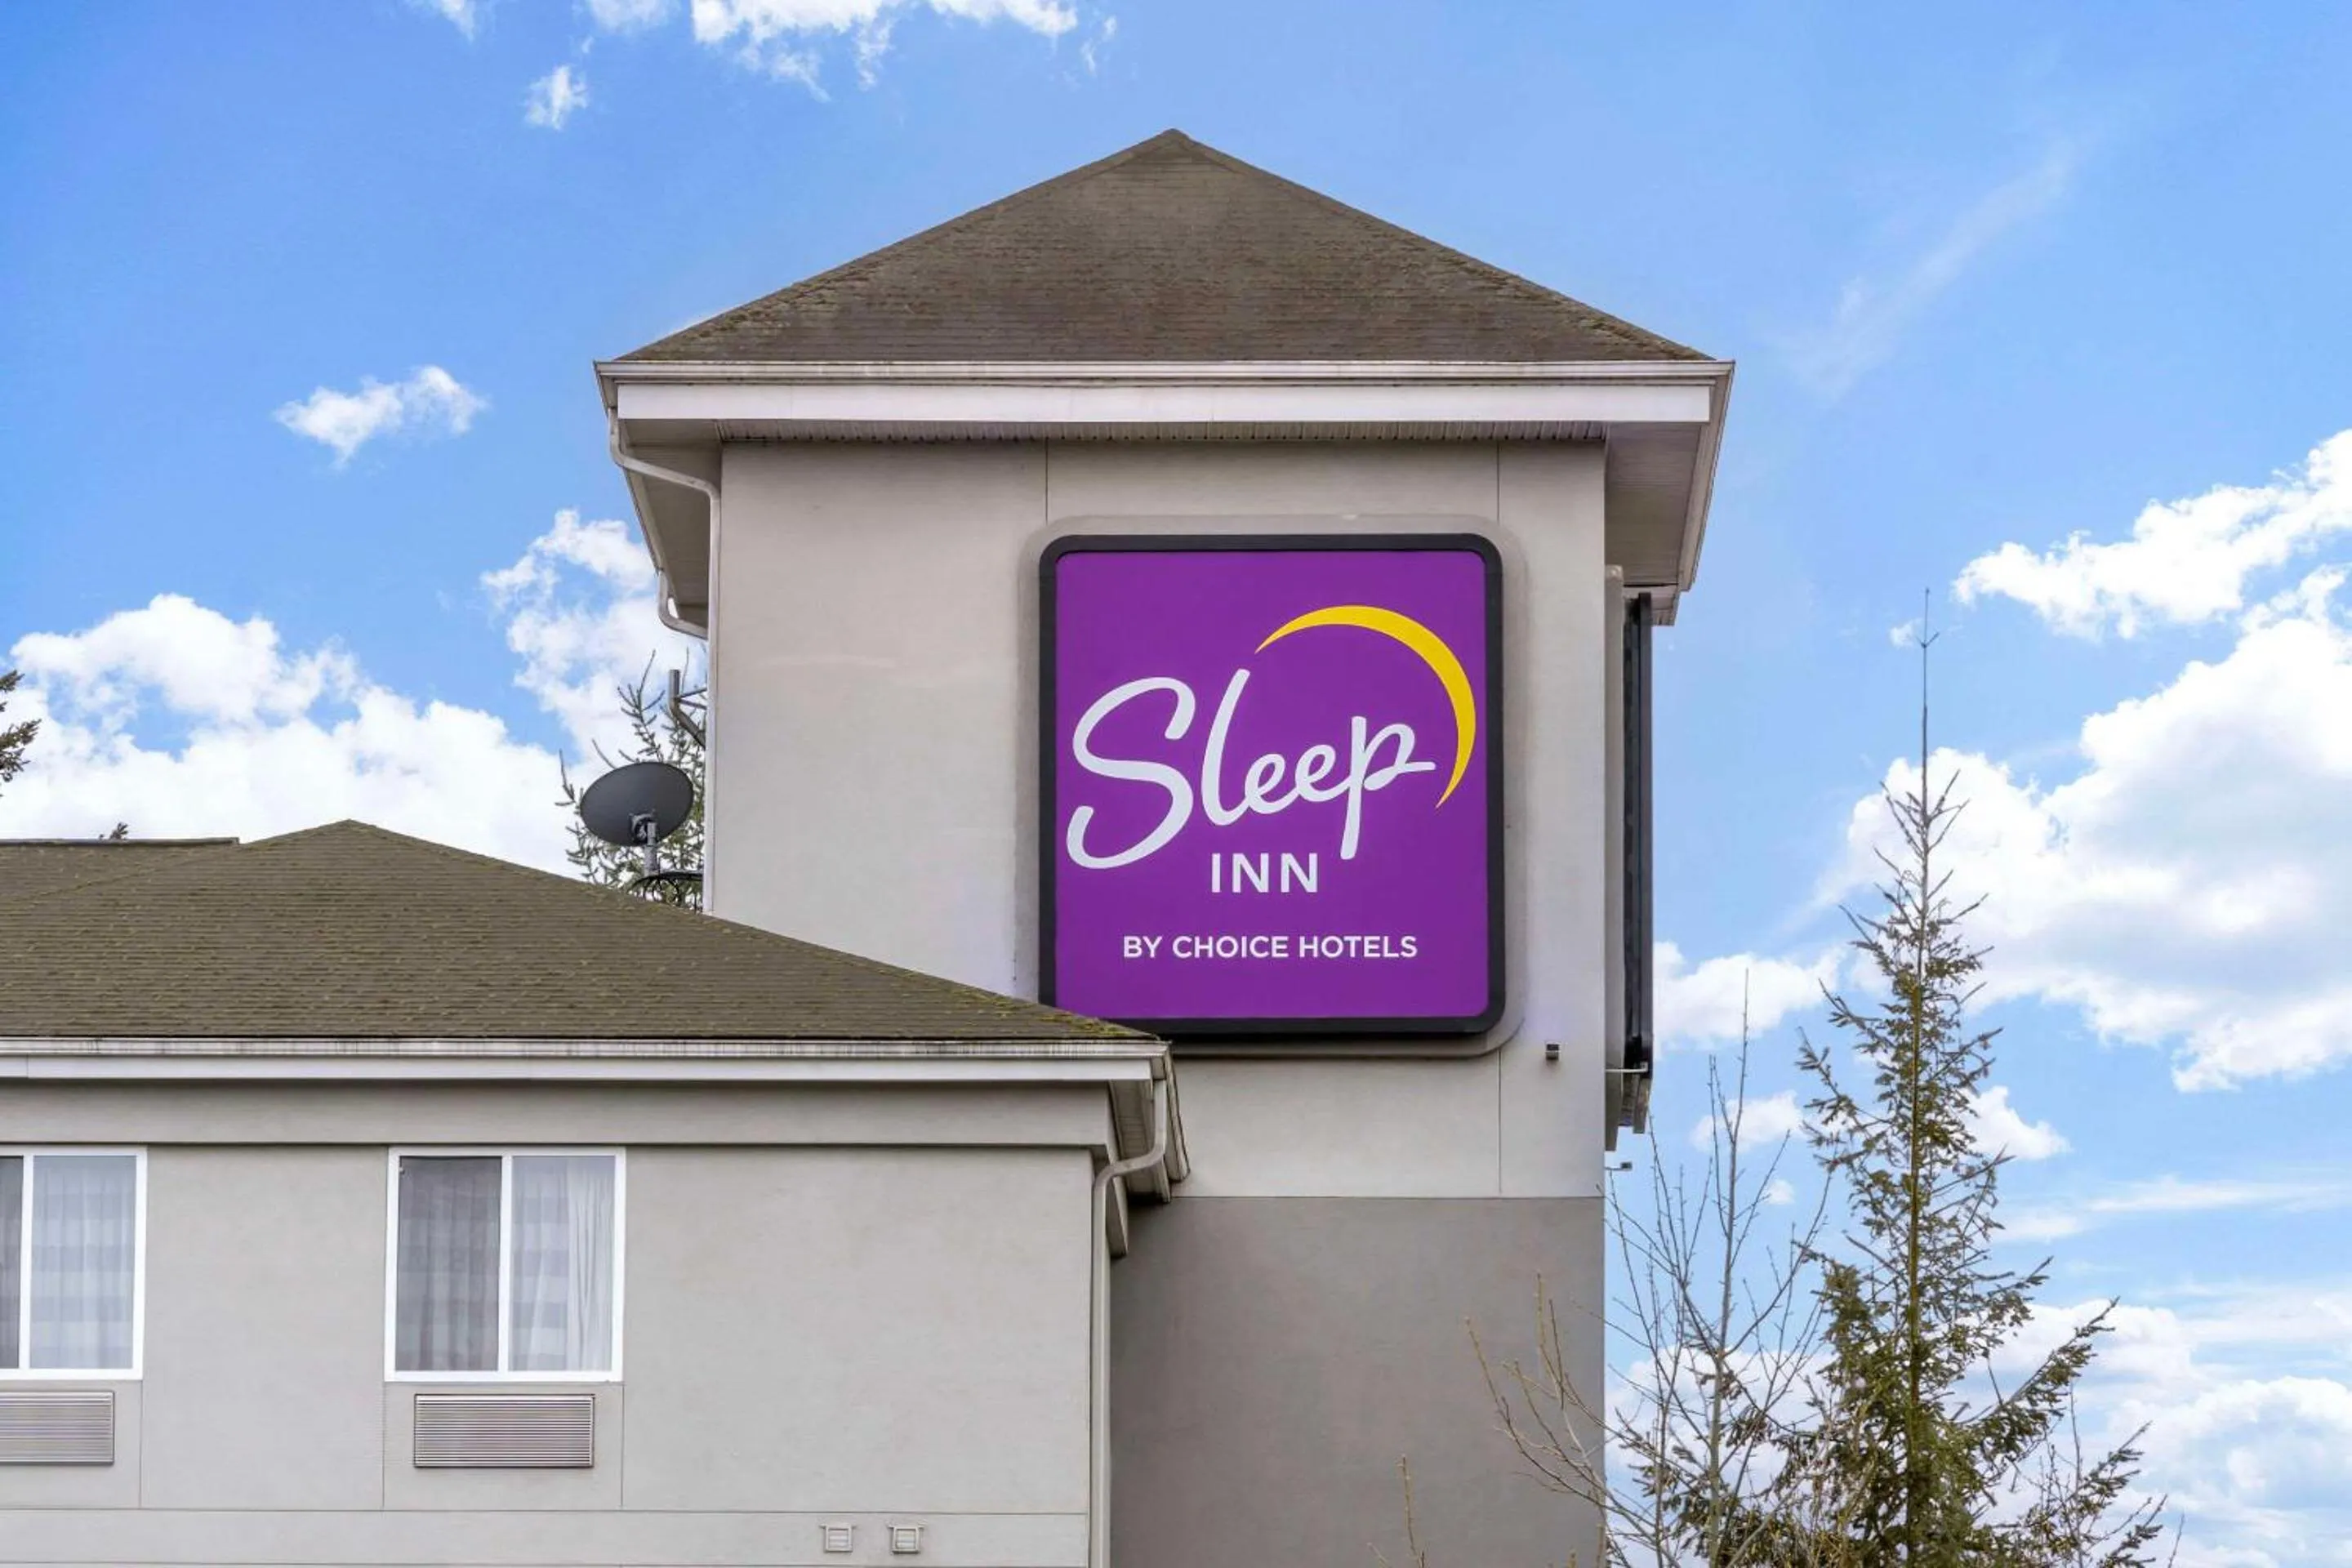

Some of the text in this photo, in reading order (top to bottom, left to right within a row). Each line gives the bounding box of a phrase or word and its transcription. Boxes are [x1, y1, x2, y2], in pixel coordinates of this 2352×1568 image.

[1066, 668, 1437, 870] Sleep
[1210, 852, 1318, 893] INN
[1123, 935, 1419, 959] BY CHOICE HOTELS
